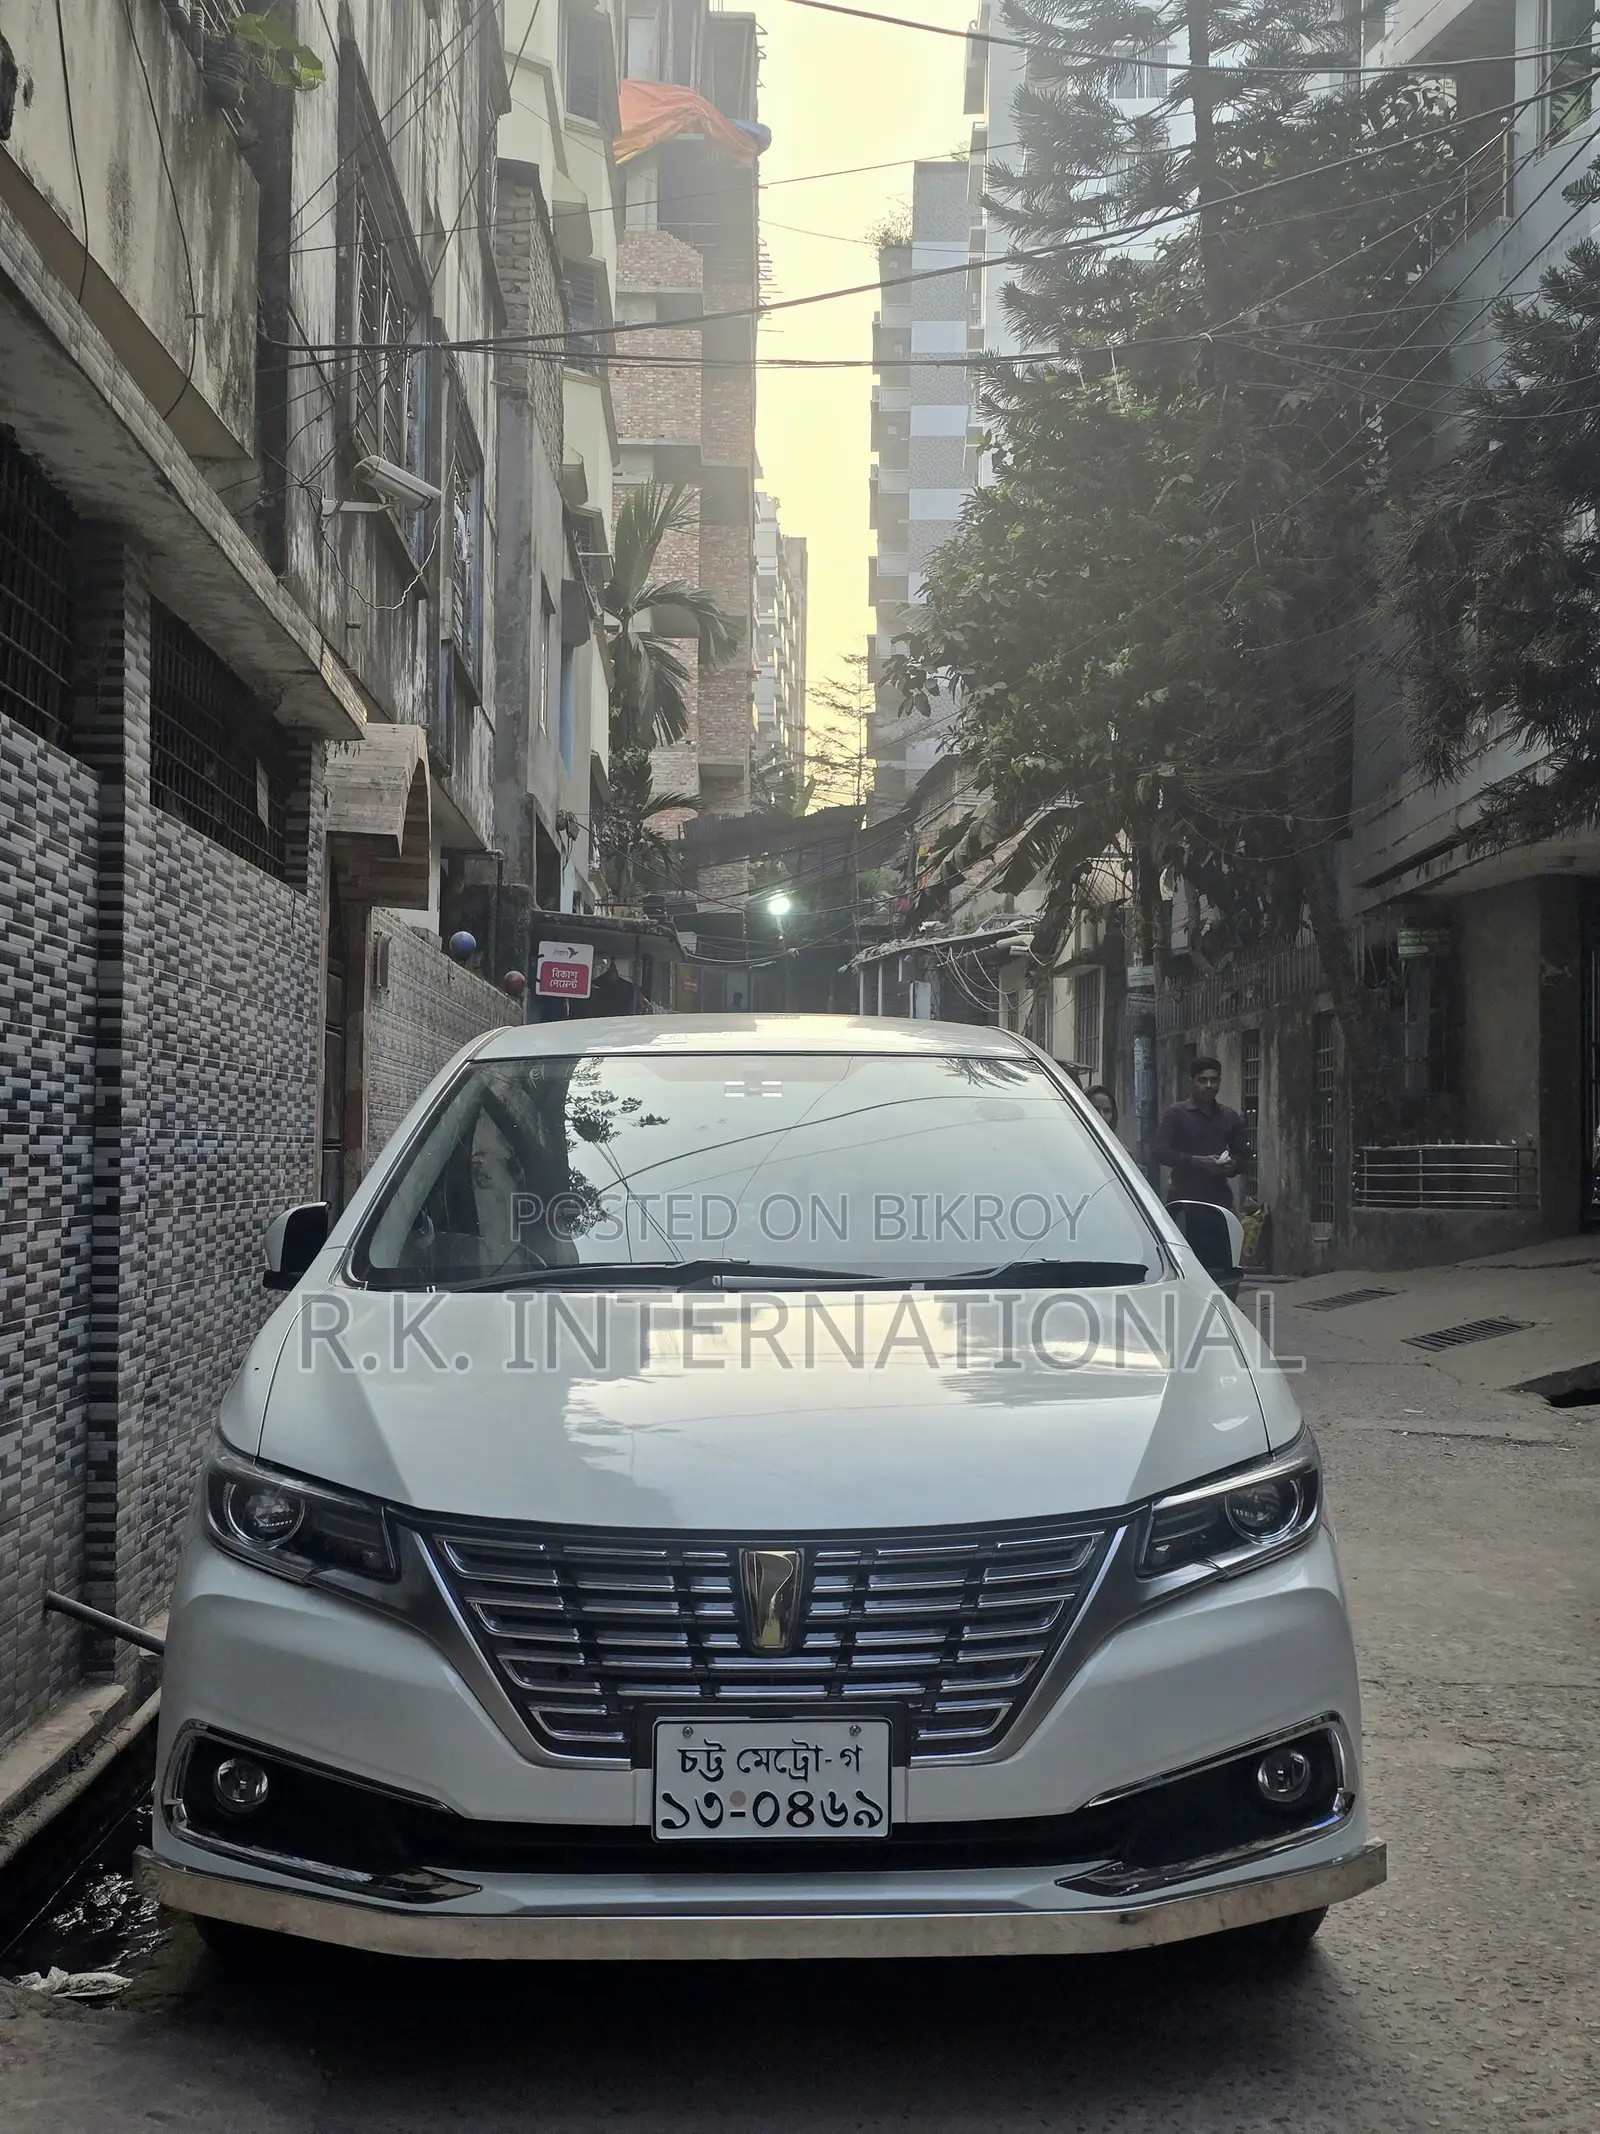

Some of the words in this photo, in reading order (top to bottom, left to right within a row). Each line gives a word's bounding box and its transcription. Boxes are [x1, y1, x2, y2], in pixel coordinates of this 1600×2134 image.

[550, 979, 578, 987] পেমেন্ট
[552, 968, 578, 979] বিকাশ
[677, 1738, 727, 1783] চট্ট
[660, 1789, 884, 1830] ১৩-০৪৬৯
